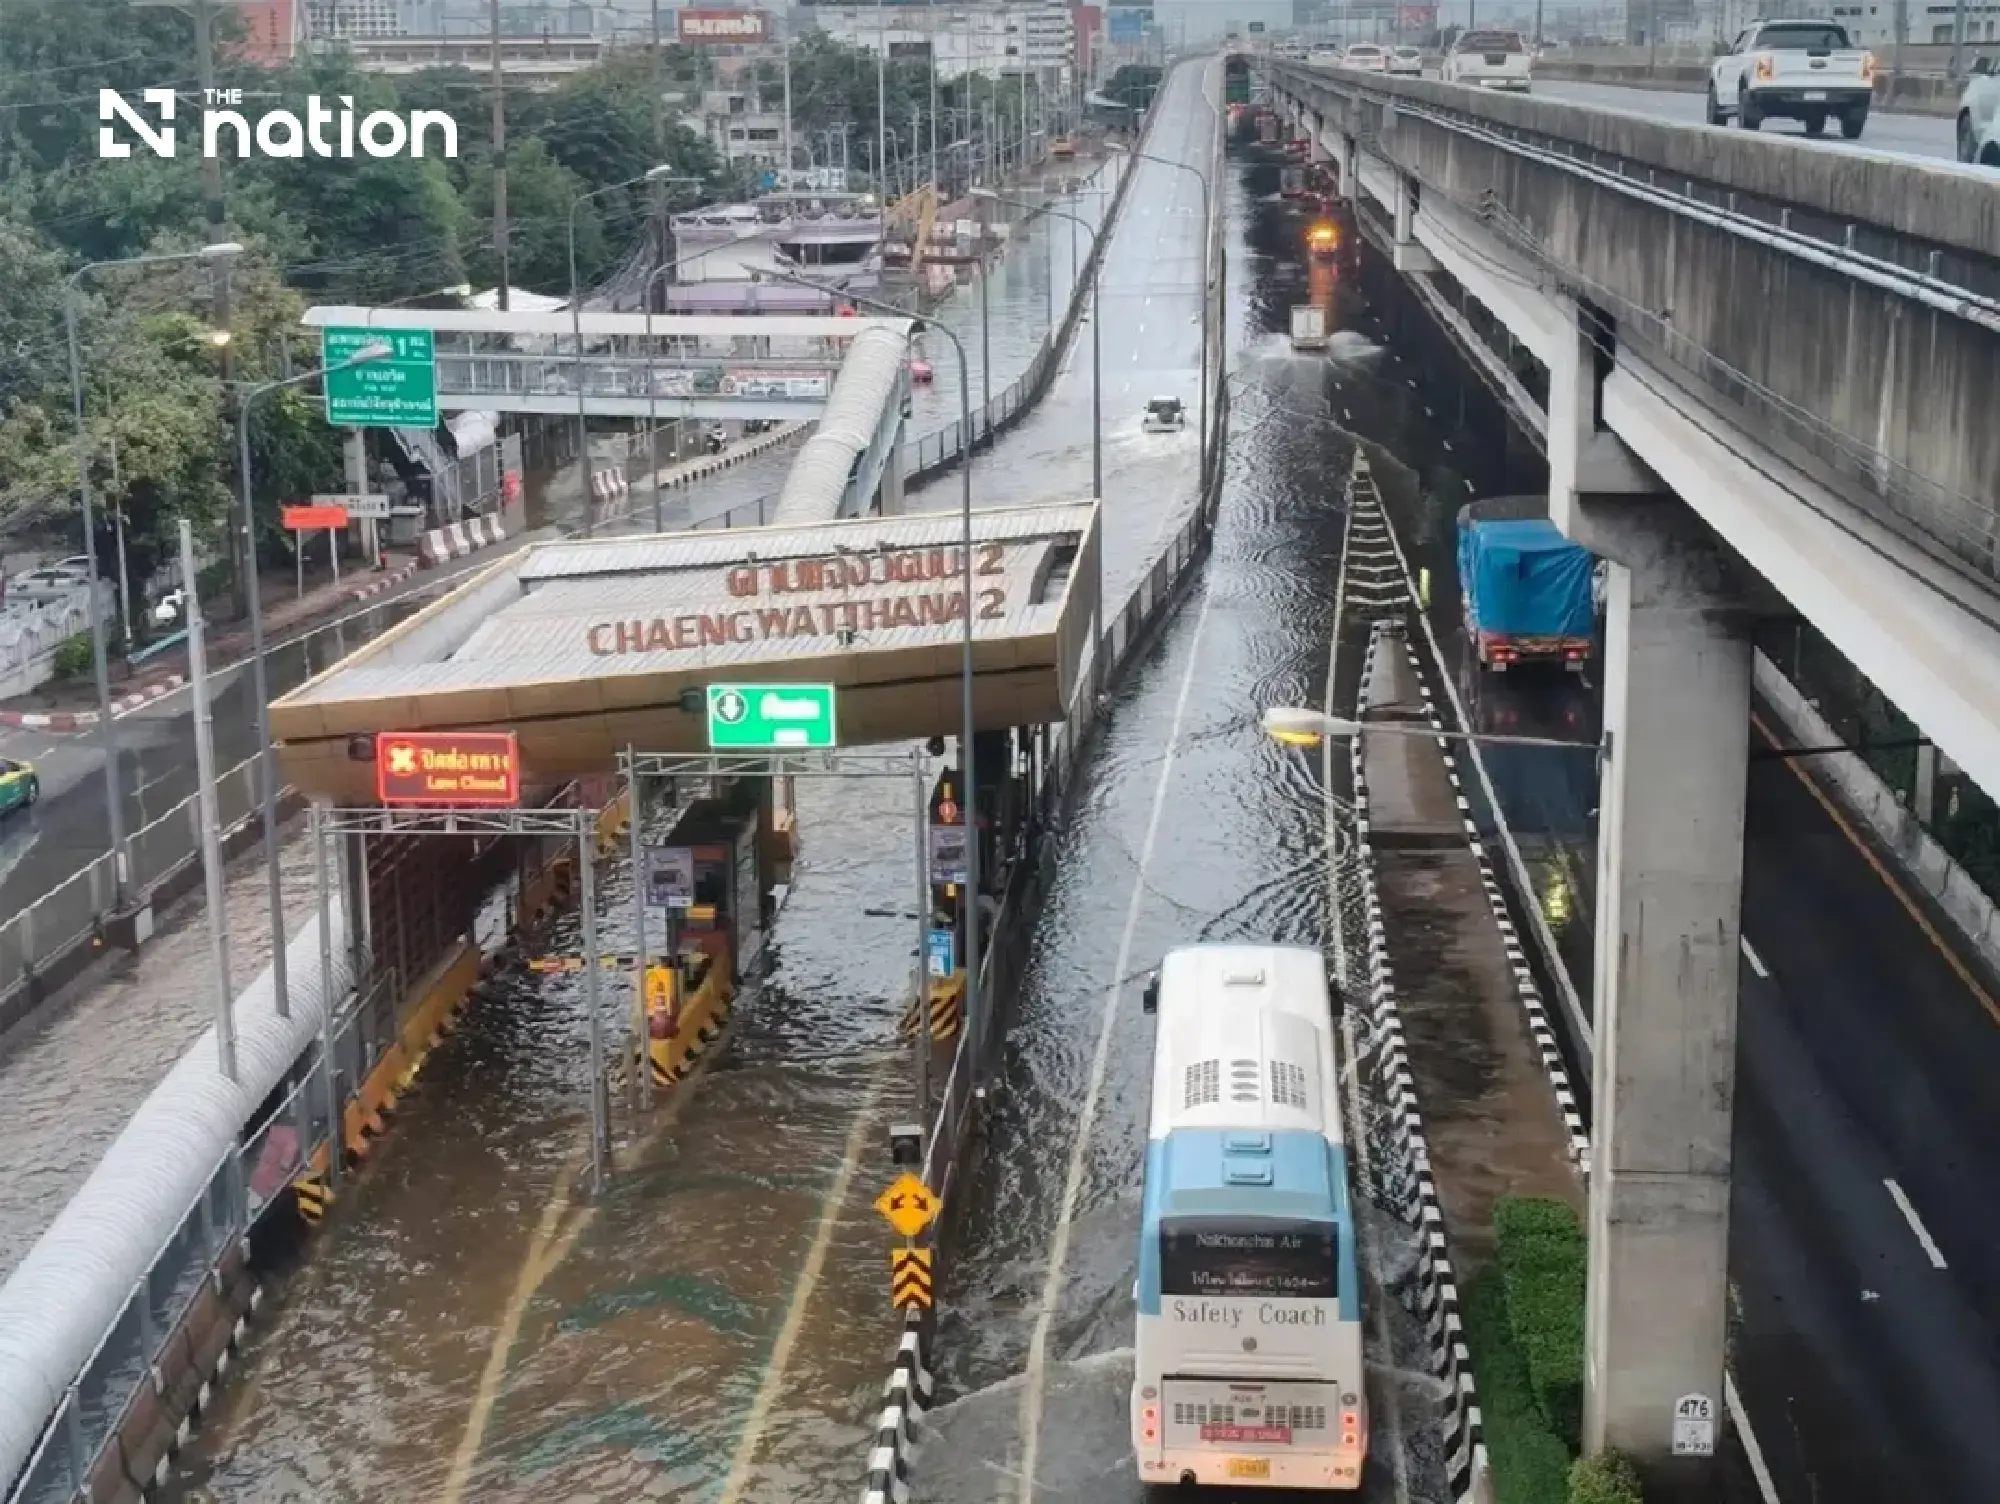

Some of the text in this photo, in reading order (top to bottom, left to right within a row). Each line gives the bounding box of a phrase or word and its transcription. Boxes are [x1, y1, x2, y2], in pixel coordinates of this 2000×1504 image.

[978, 544, 1004, 576] 2
[979, 588, 1006, 620] 2
[1173, 1299, 1327, 1328] Safety Coach
[1680, 1399, 1708, 1417] 476
